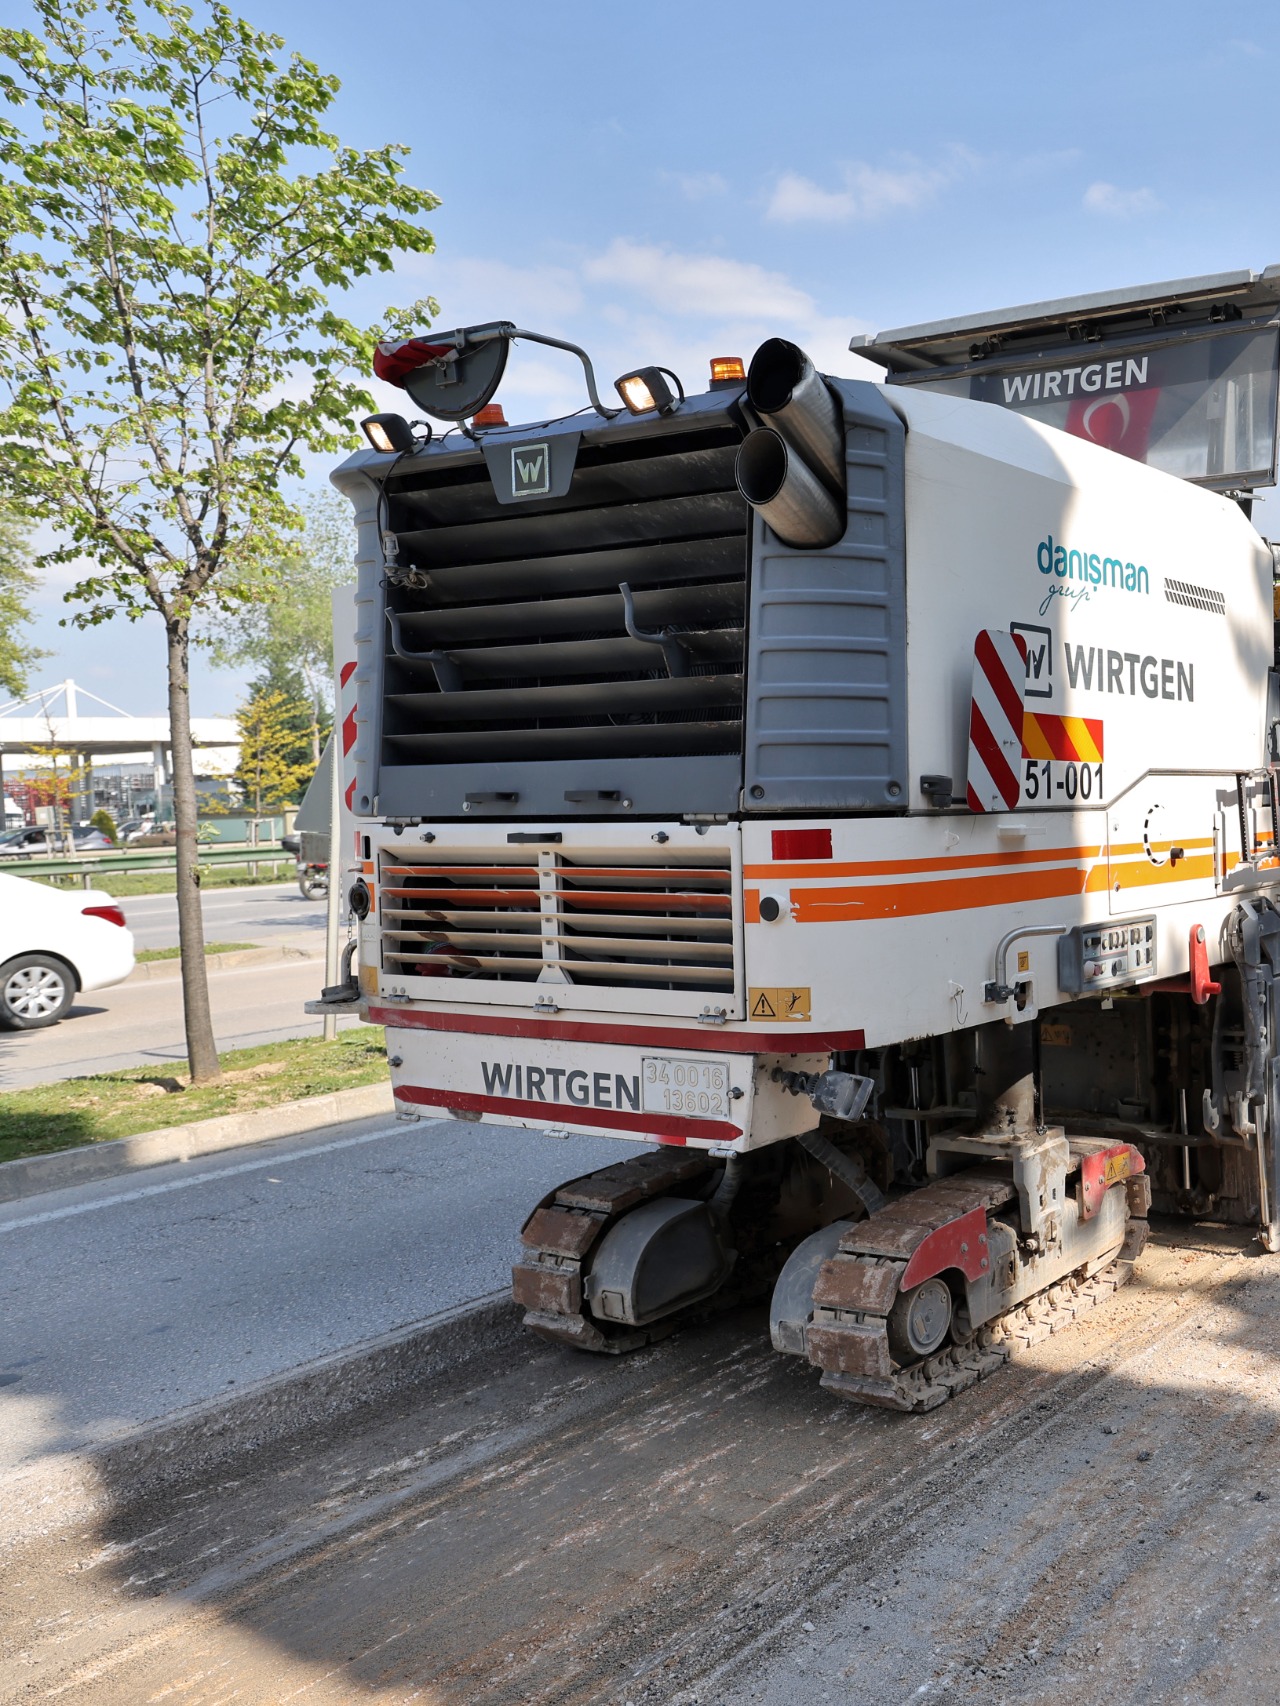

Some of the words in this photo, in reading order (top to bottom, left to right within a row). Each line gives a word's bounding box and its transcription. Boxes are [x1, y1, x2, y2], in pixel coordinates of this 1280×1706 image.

[1002, 356, 1149, 403] WIRTGEN
[1039, 583, 1091, 616] grup
[1064, 641, 1194, 702] WIRTGEN
[1024, 760, 1104, 800] 51-001
[481, 1061, 641, 1111] WIRTGEN
[646, 1063, 670, 1086] 34
[674, 1064, 699, 1088] 00
[702, 1066, 724, 1090] 16
[663, 1088, 723, 1115] 13602
